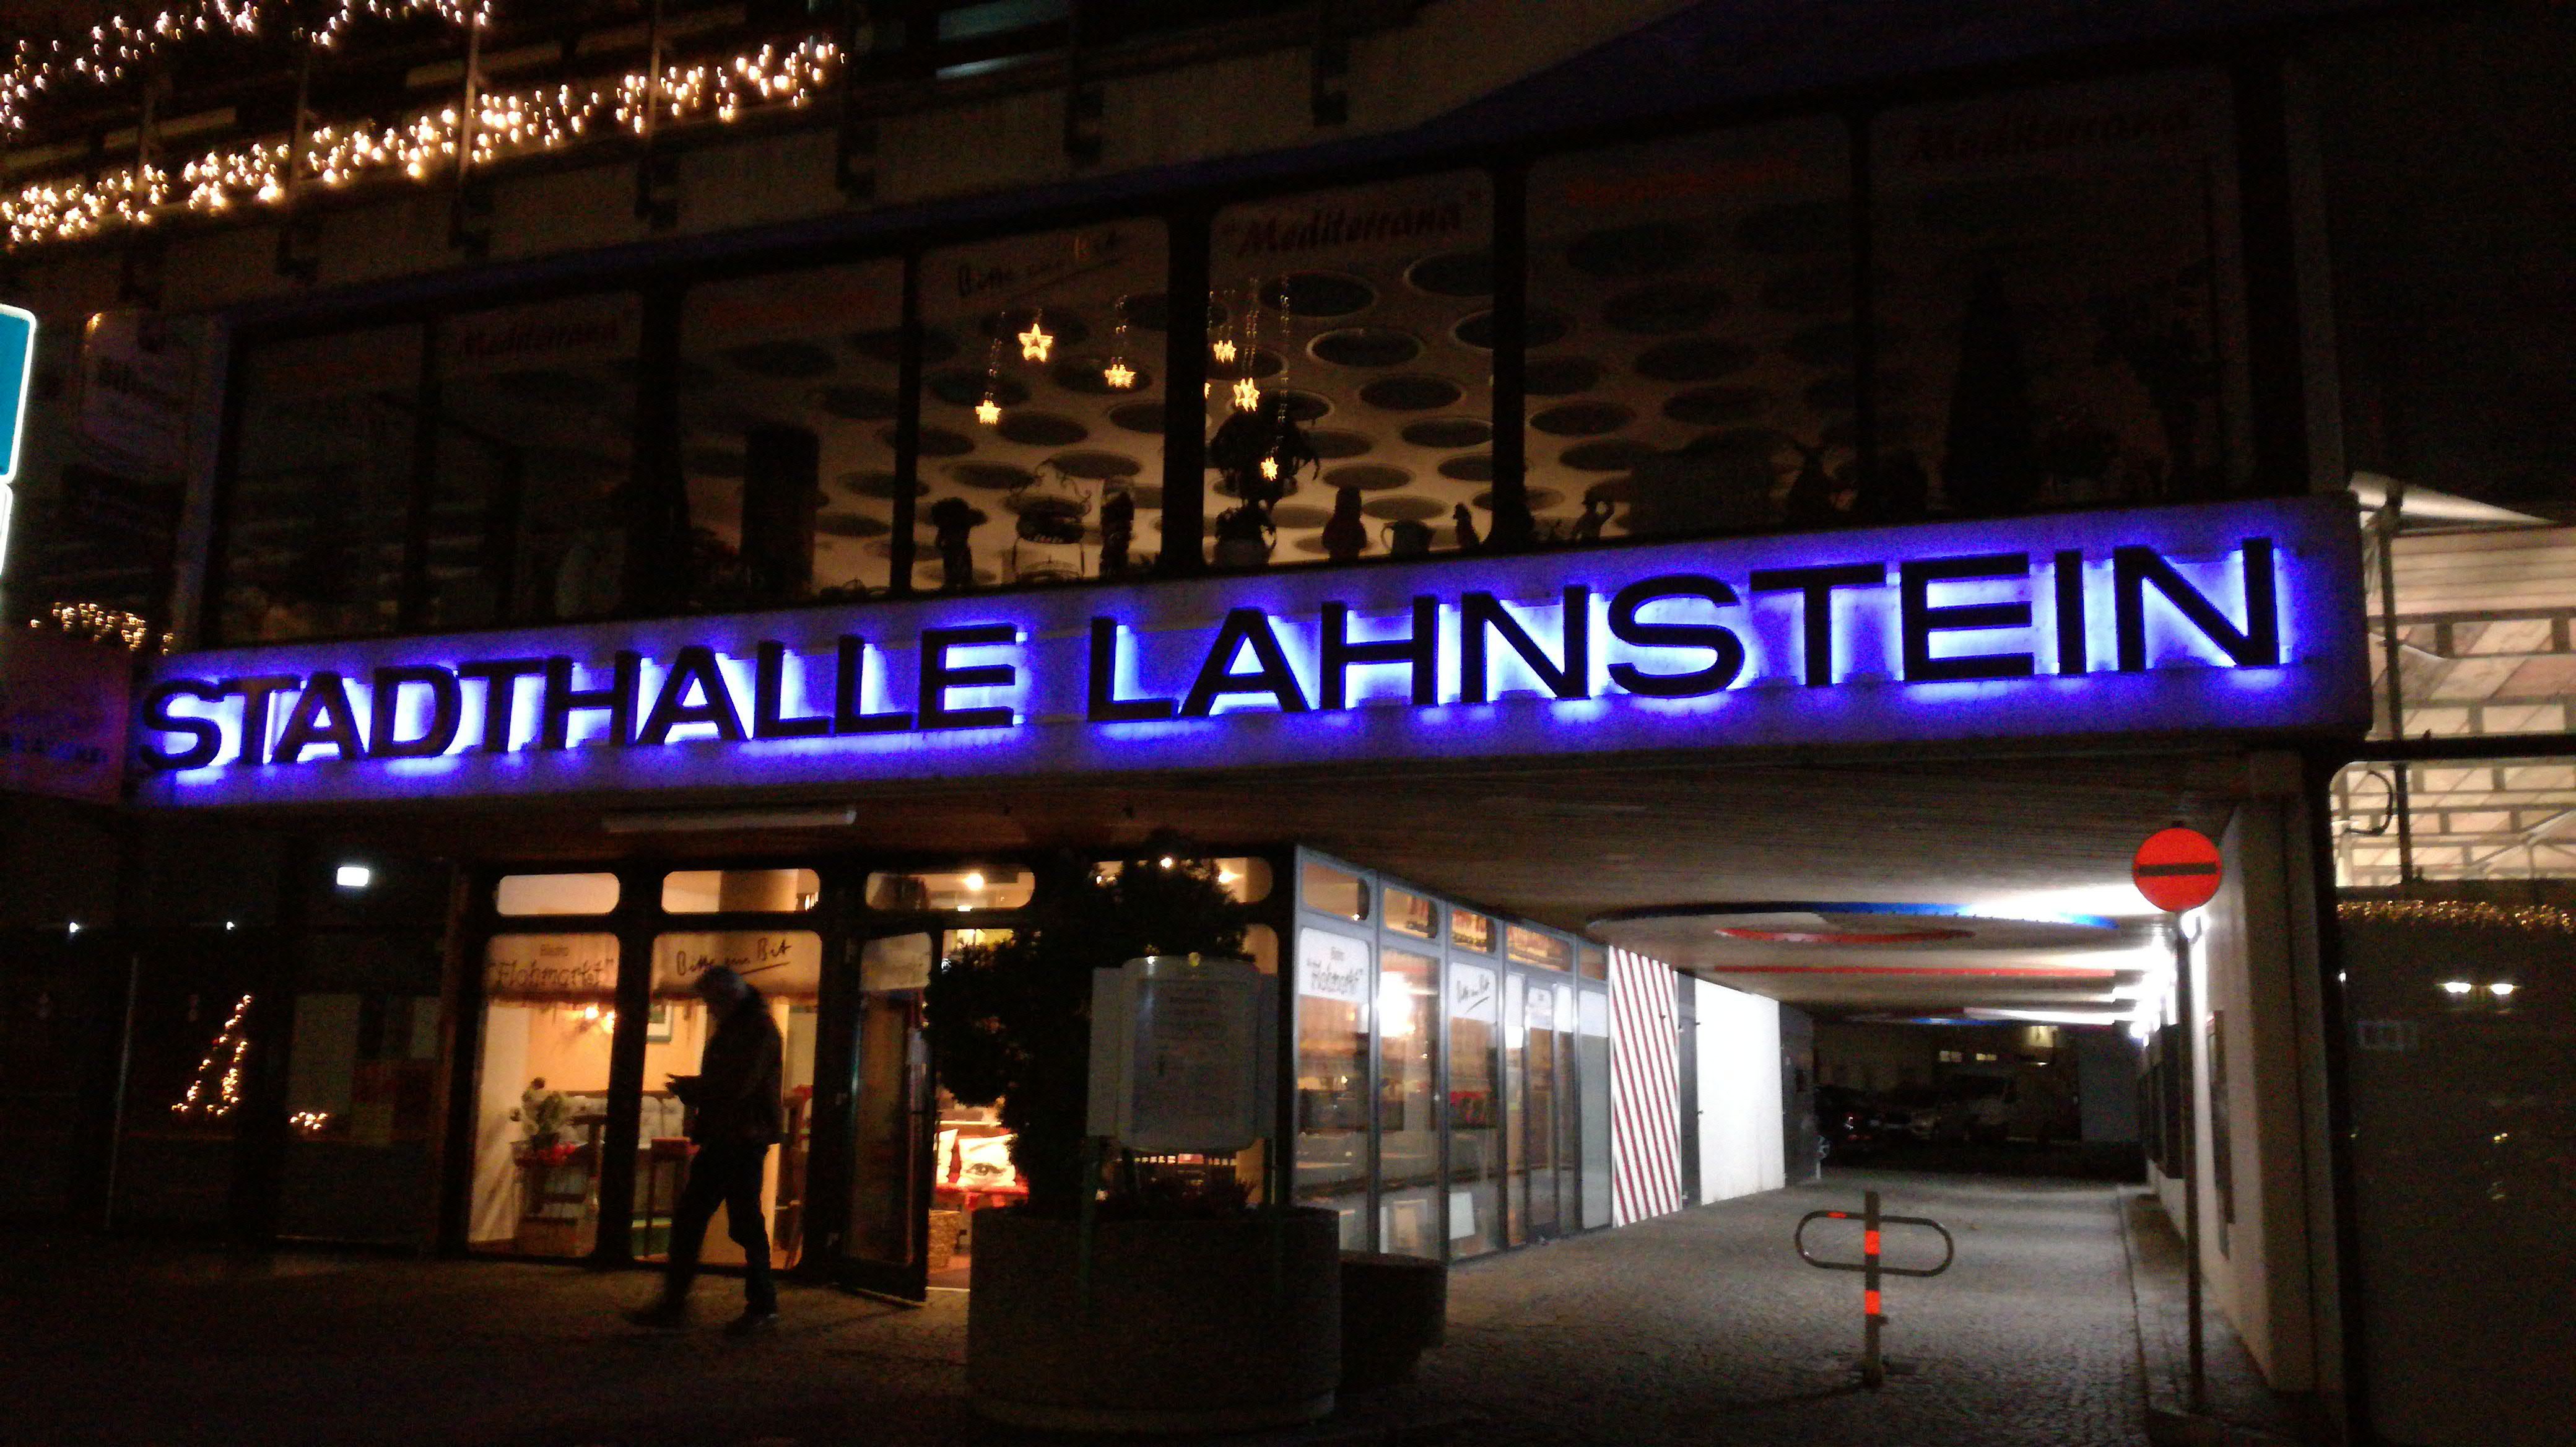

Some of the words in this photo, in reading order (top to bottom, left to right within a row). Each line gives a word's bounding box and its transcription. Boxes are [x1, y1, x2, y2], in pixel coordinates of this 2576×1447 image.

[141, 623, 1017, 771] STADTHALLE
[1088, 538, 2279, 721] LAHNSTEIN
[757, 937, 792, 961] Bit
